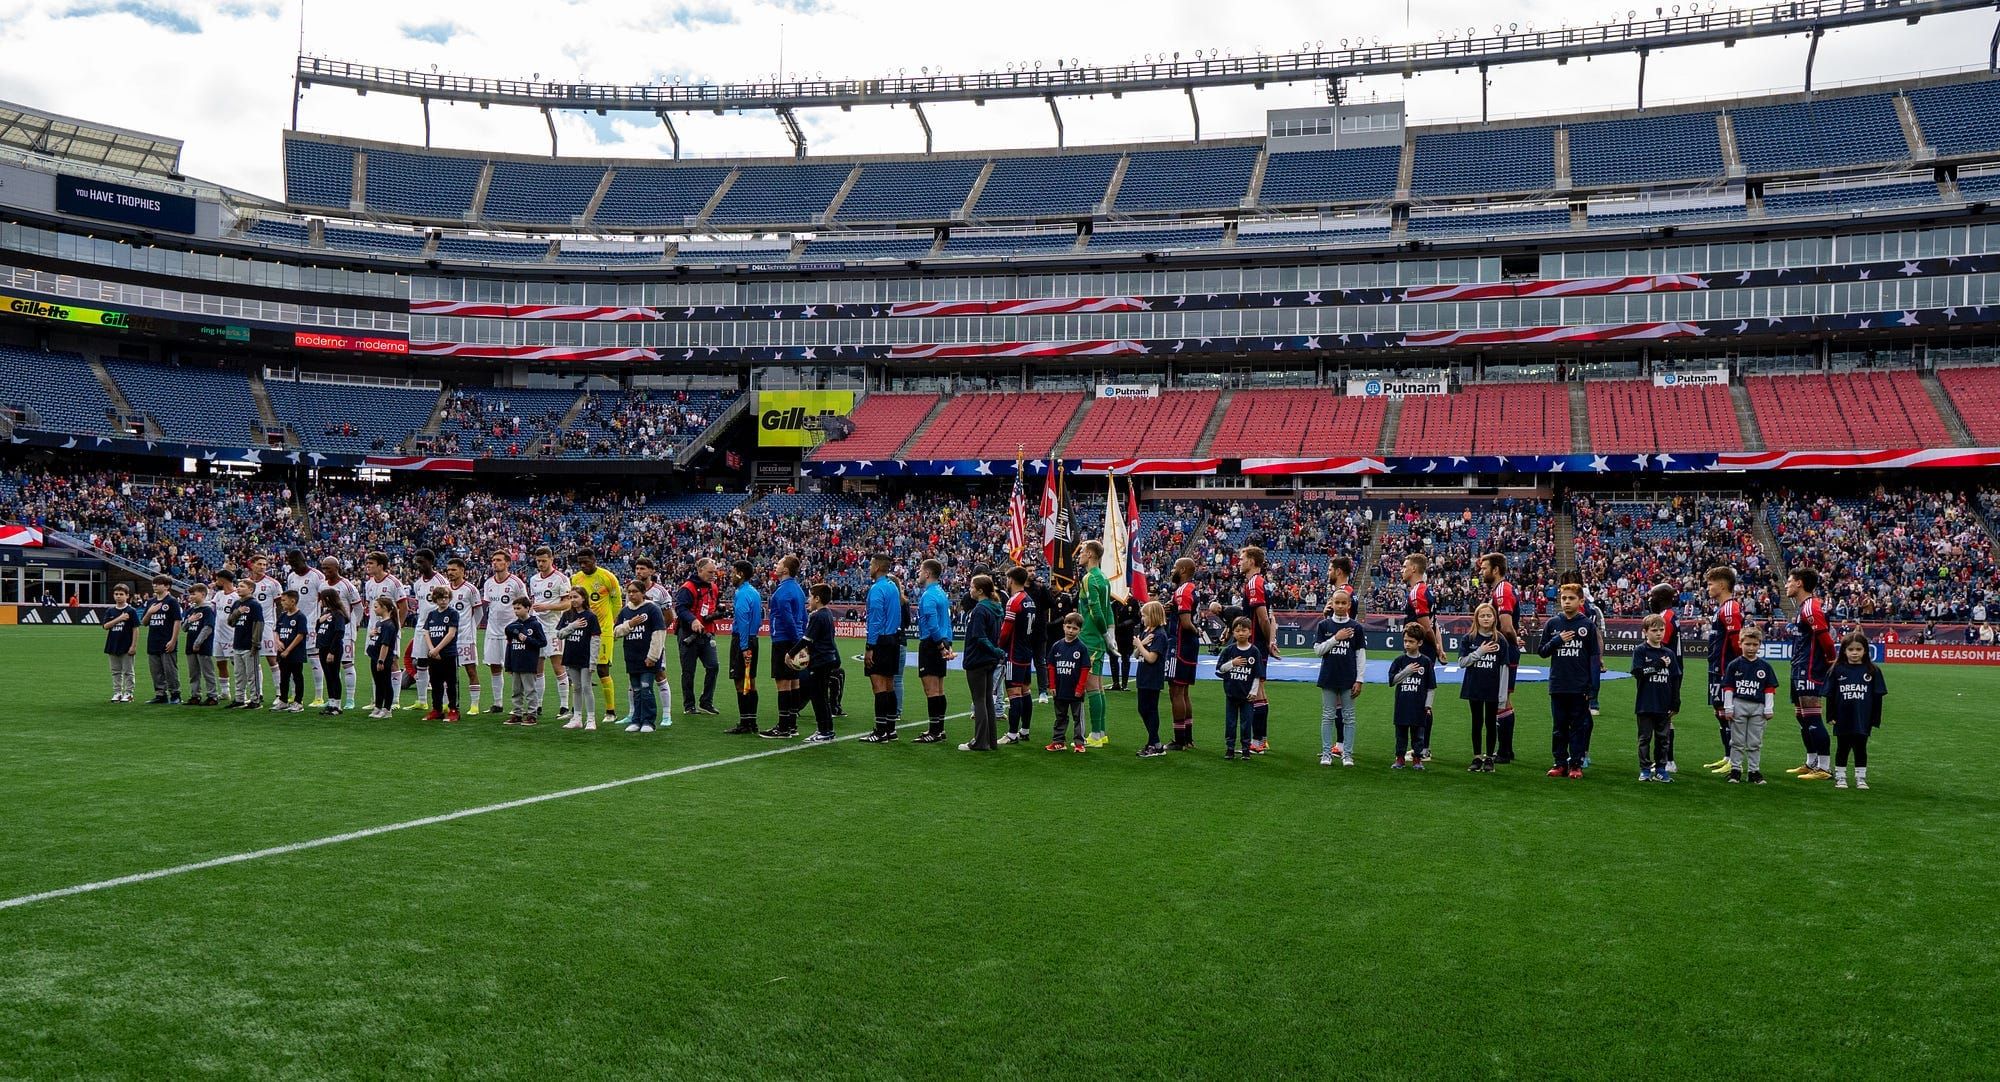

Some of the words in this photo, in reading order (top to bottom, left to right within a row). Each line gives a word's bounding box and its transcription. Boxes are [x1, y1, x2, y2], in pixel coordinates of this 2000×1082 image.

[75, 188, 88, 198] YOU
[89, 189, 114, 204] HAVE
[116, 194, 161, 212] TROPHIES
[10, 299, 70, 320] Gillette
[295, 334, 346, 348] moderna
[355, 339, 406, 352] moderna
[1677, 375, 1717, 383] Putnam
[1383, 382, 1440, 394] Putnam
[1557, 648, 1579, 657] TEAM
[1886, 649, 1931, 659] BECOME
[1931, 650, 1940, 660] A
[1941, 650, 1984, 661] SEASON
[1056, 660, 1076, 669] DREAM
[1230, 672, 1248, 681] TEAM
[1401, 684, 1418, 692] TEAM
[1735, 679, 1760, 689] DREAM
[1839, 683, 1868, 693] DREAM
[1736, 687, 1757, 696] TEAM
[1843, 692, 1865, 700] TEAM
